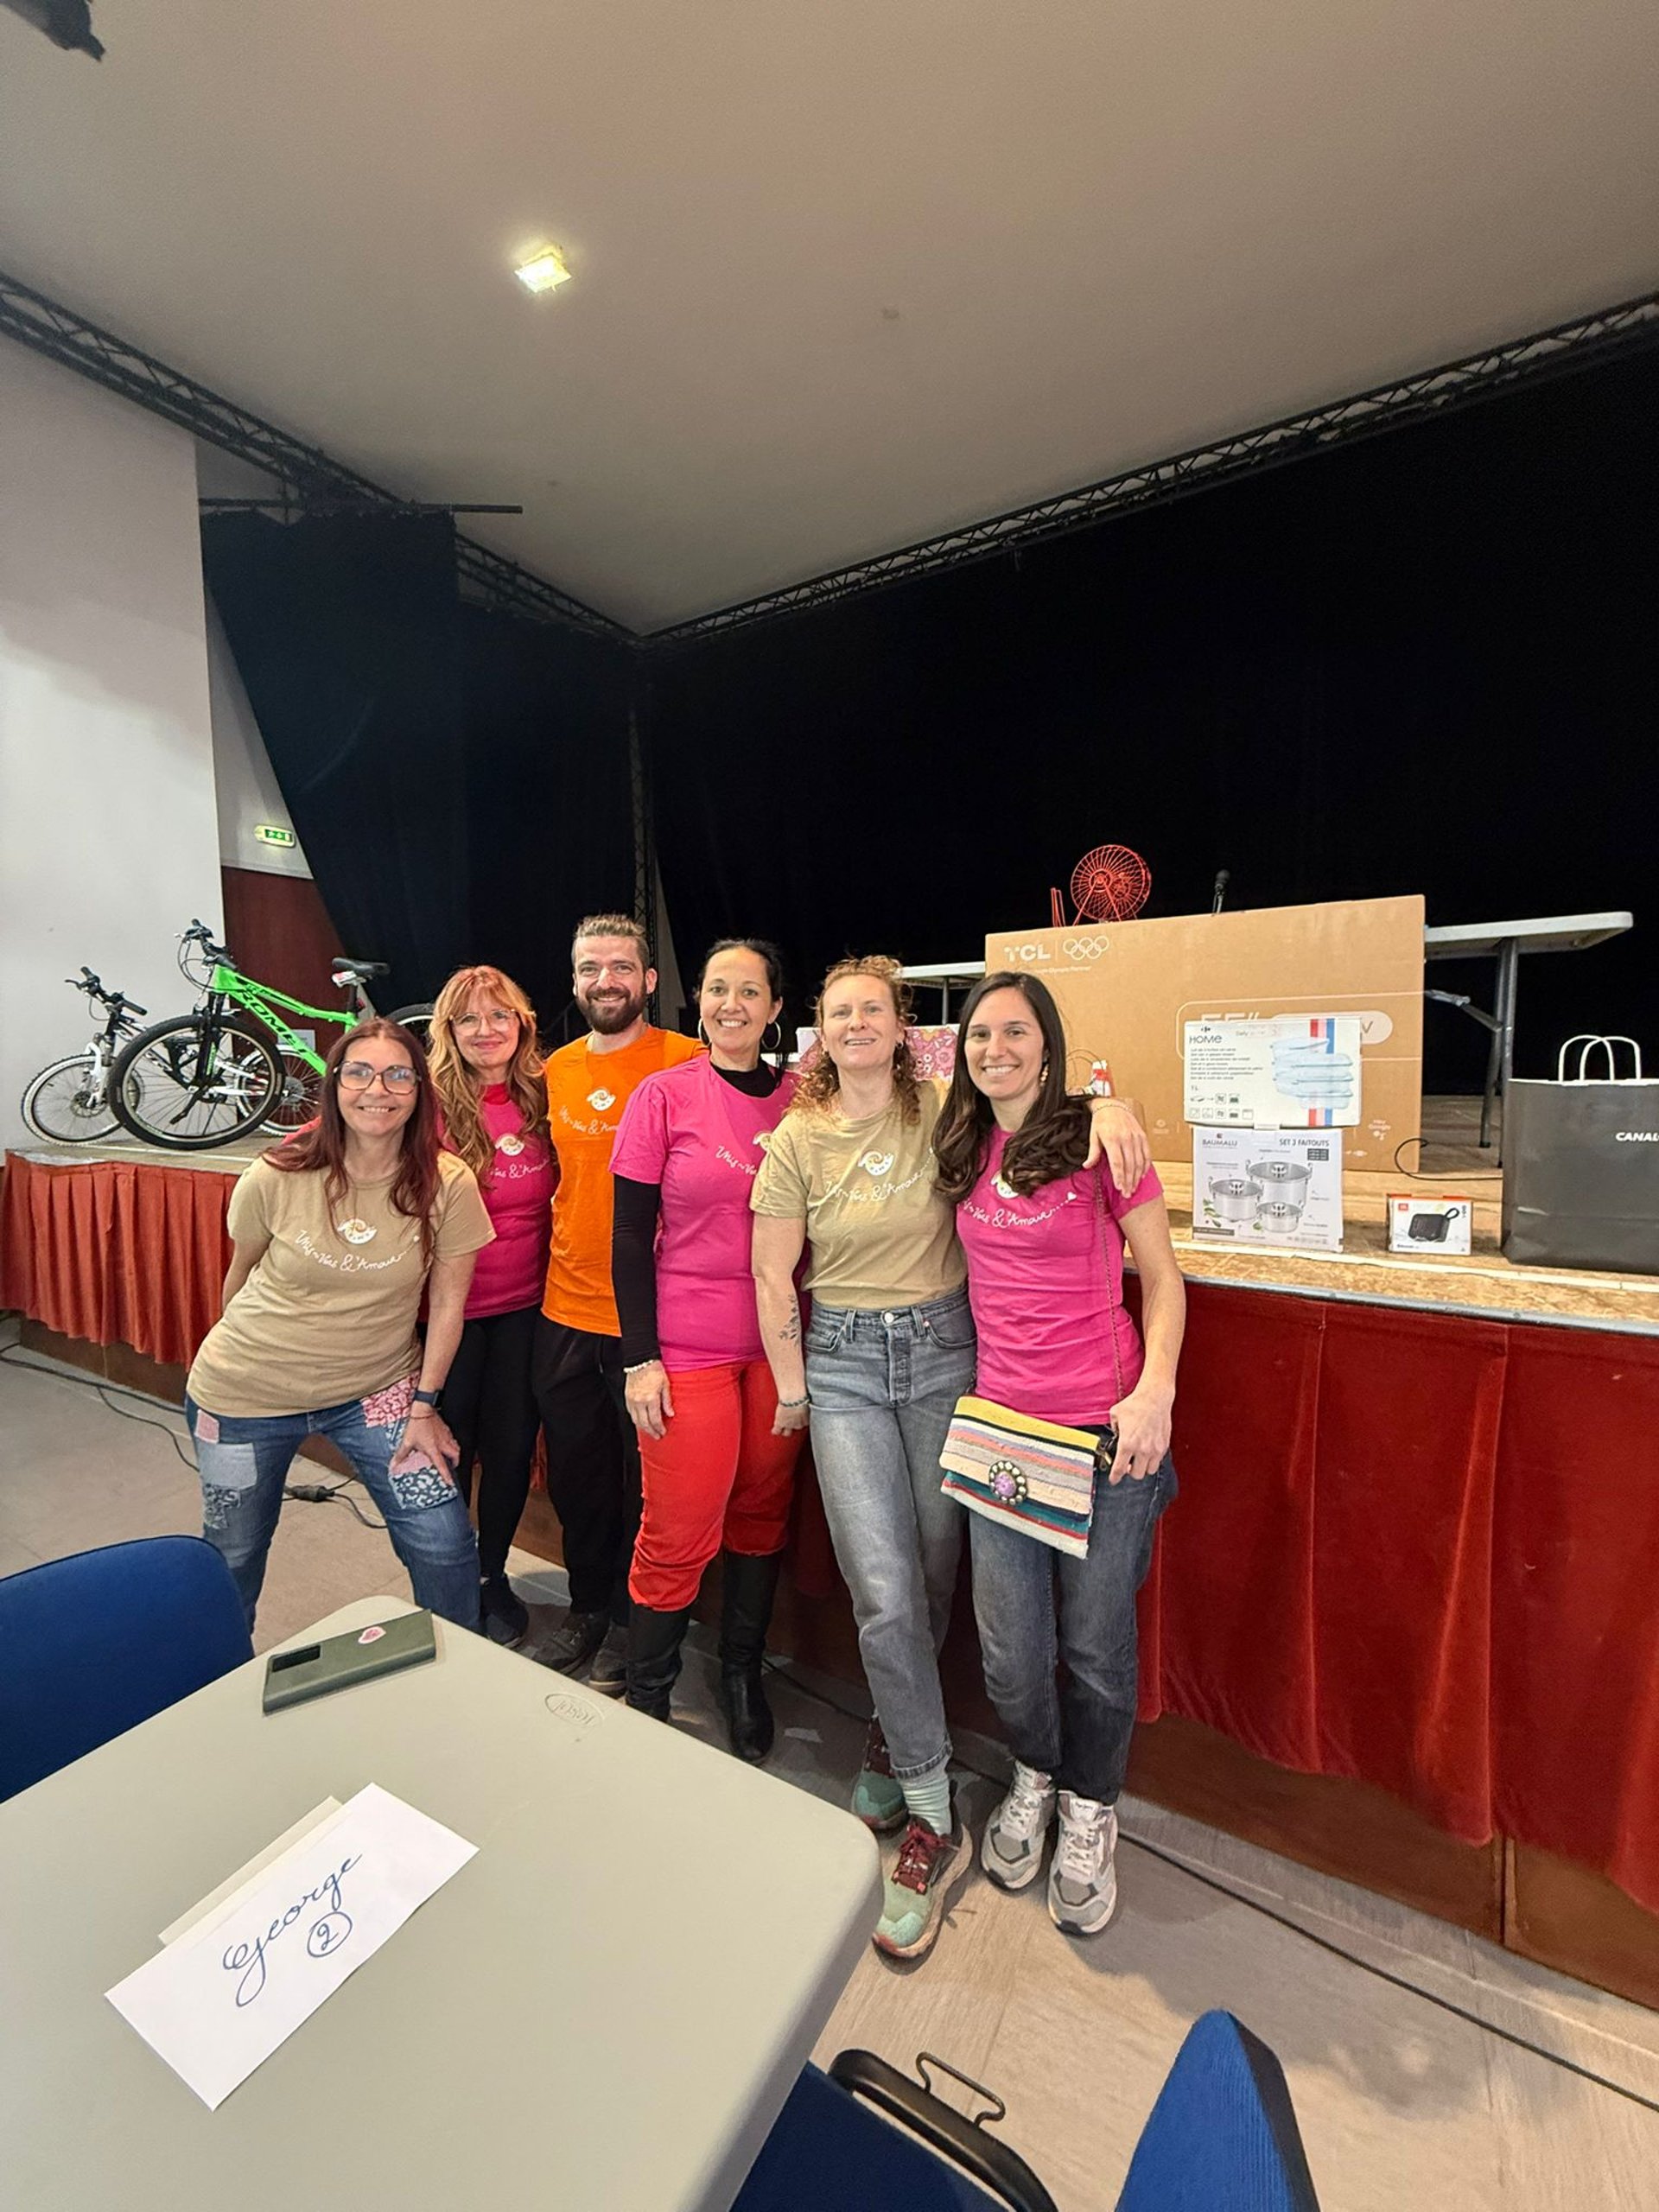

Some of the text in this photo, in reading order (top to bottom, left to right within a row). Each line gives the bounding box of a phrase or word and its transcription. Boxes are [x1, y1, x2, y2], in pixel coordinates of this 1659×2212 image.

[1004, 944, 1051, 962] TCL
[1279, 1138, 1292, 1147] SET
[1615, 1132, 1659, 1141] CANAL
[222, 1853, 363, 2007] George
